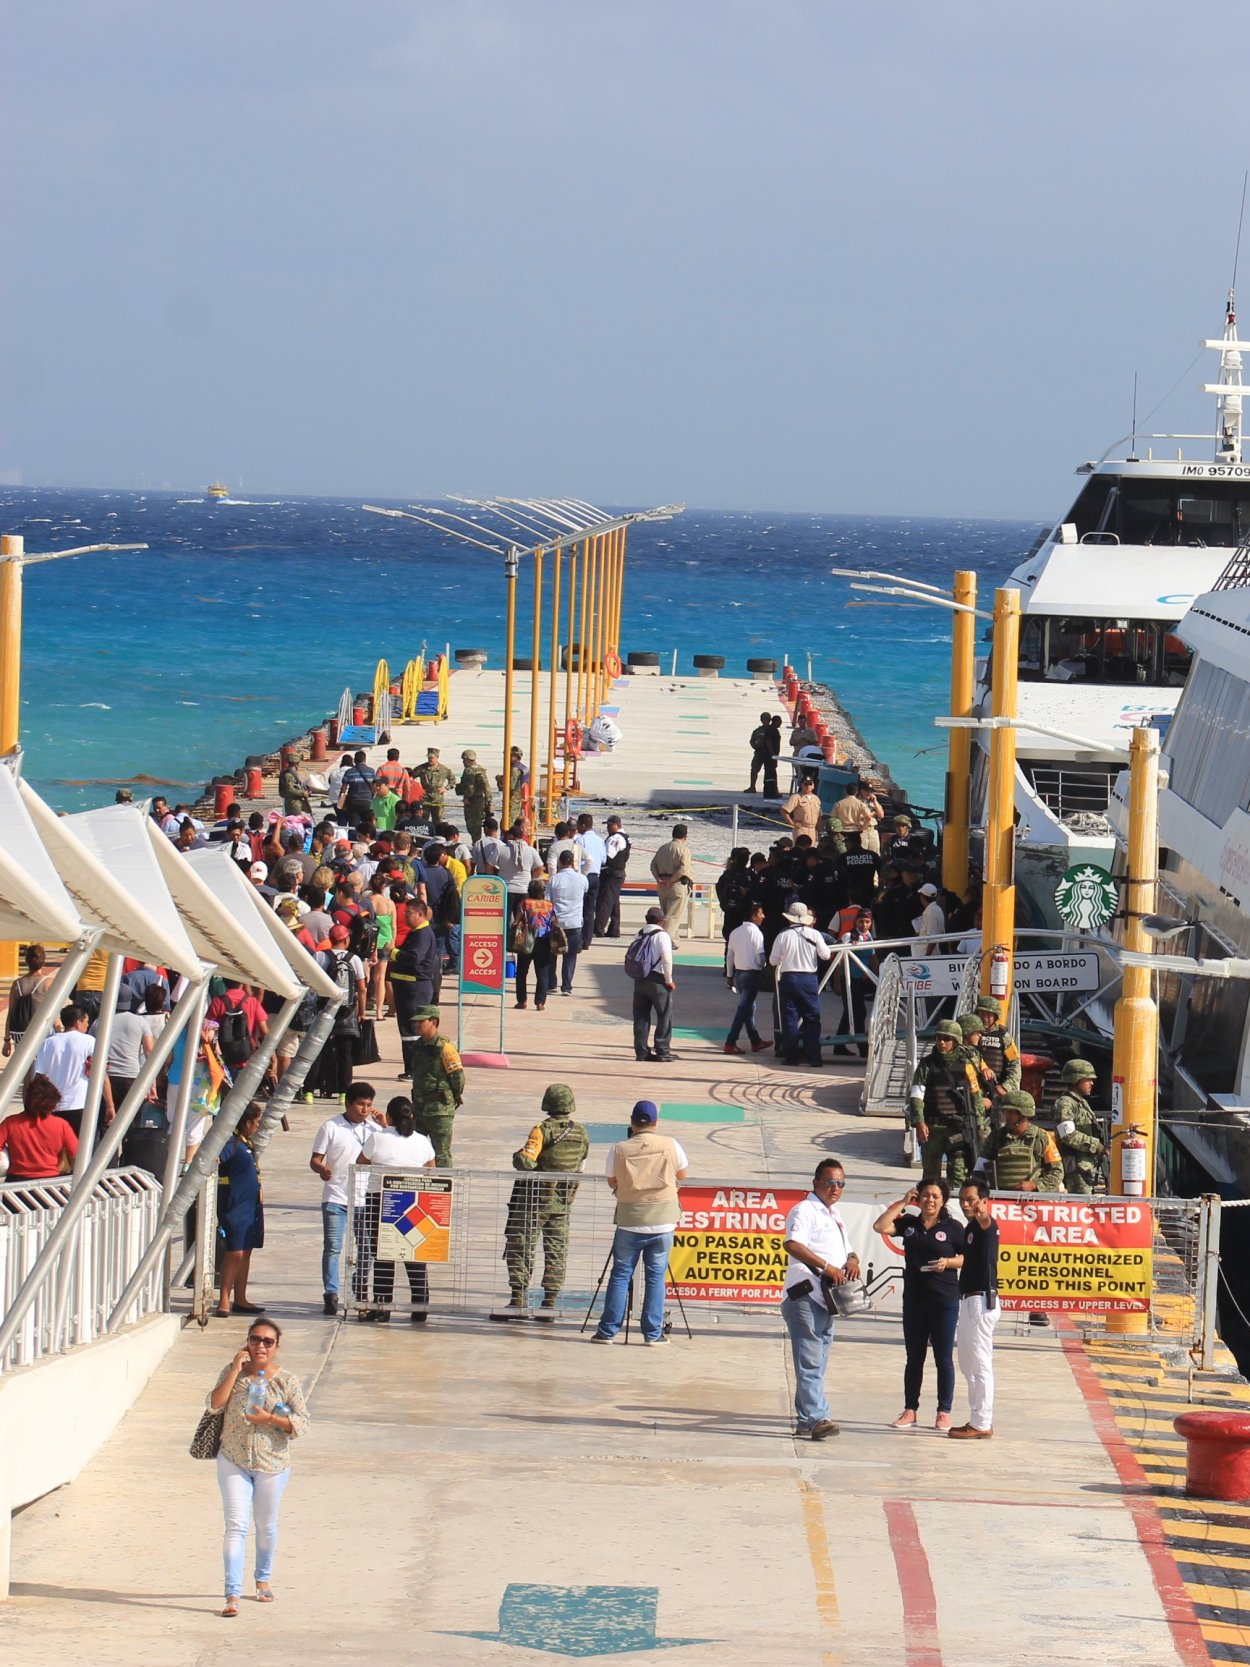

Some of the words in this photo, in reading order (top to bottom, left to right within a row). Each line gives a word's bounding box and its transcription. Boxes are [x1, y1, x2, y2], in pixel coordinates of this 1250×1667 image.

[1182, 466, 1204, 475] IMO
[1035, 960, 1042, 969] A
[1047, 959, 1086, 969] BORDO
[1036, 978, 1078, 988] BOARD
[712, 1190, 778, 1210] AREA
[674, 1211, 786, 1230] ESTRING
[991, 1204, 1141, 1224] RESTRICTED
[673, 1235, 699, 1248] NO
[705, 1236, 764, 1249] PASAR
[1033, 1226, 1099, 1244] AREA
[997, 1251, 1011, 1262] O
[1017, 1252, 1143, 1265] UNAUTHORIZED
[685, 1267, 786, 1282] AUTORIZAD
[1017, 1266, 1114, 1278] PERSONNEL
[997, 1278, 1050, 1290] EYOND
[1055, 1280, 1092, 1291] THIS
[1098, 1282, 1146, 1292] POINT
[666, 1287, 697, 1296] CCESO
[709, 1289, 739, 1298] FERRY
[742, 1289, 761, 1298] POR
[1000, 1299, 1018, 1309] RRY
[1020, 1300, 1059, 1309] ACCESS
[1078, 1301, 1112, 1310] UPPER
[1114, 1301, 1145, 1310] LEVEL
